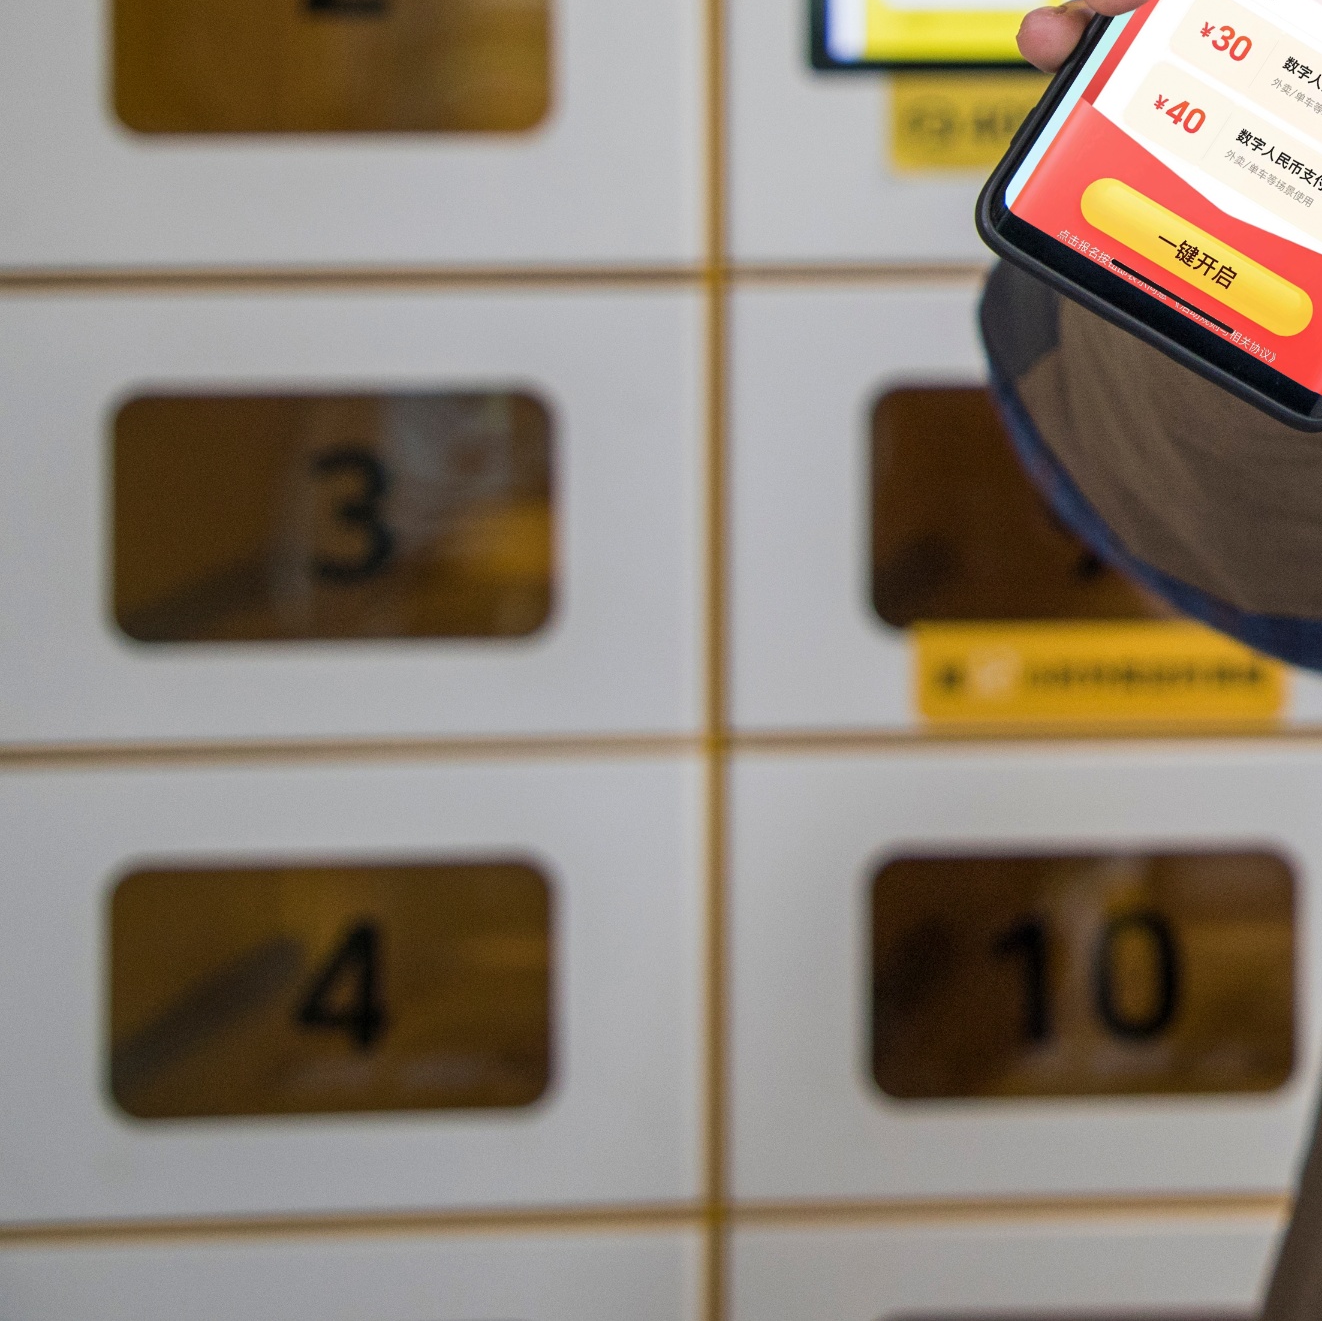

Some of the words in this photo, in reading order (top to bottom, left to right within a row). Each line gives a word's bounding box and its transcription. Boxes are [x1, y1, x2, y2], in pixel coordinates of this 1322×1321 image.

[1224, 149, 1315, 208] 外卖/单车等场景使用
[1158, 235, 1238, 290] 一键开启
[312, 444, 396, 584] 3
[295, 916, 390, 1054] 4
[990, 908, 1183, 1044] 10
